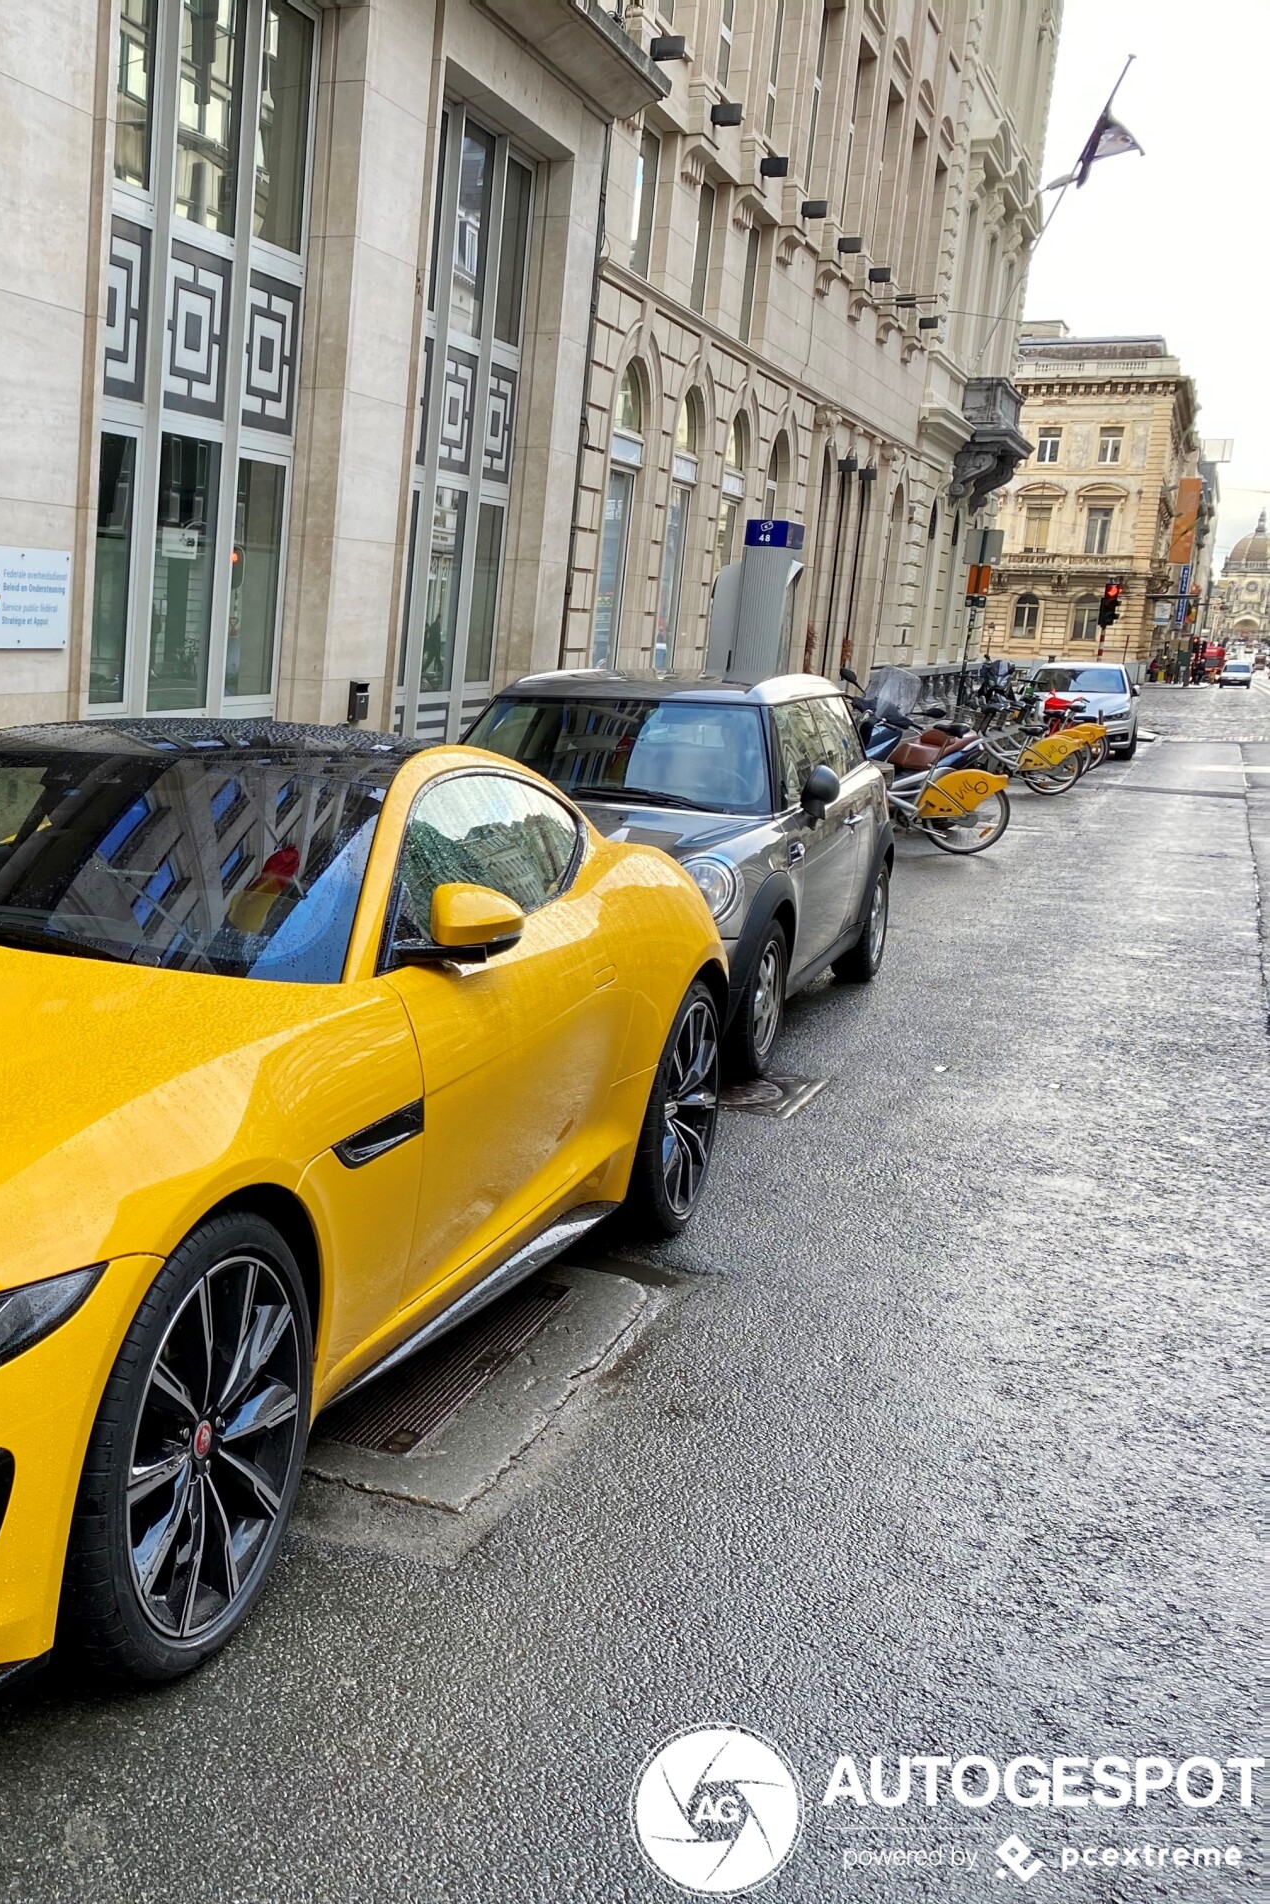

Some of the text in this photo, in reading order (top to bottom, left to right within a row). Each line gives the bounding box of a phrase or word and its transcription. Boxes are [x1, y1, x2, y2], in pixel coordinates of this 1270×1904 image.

[758, 534, 771, 542] 48
[3, 569, 26, 579] Federale
[3, 582, 20, 592] Beleid
[28, 583, 66, 595] Ondersteuning
[2, 603, 22, 612] Service
[22, 604, 39, 613] public
[33, 617, 49, 627] Appui
